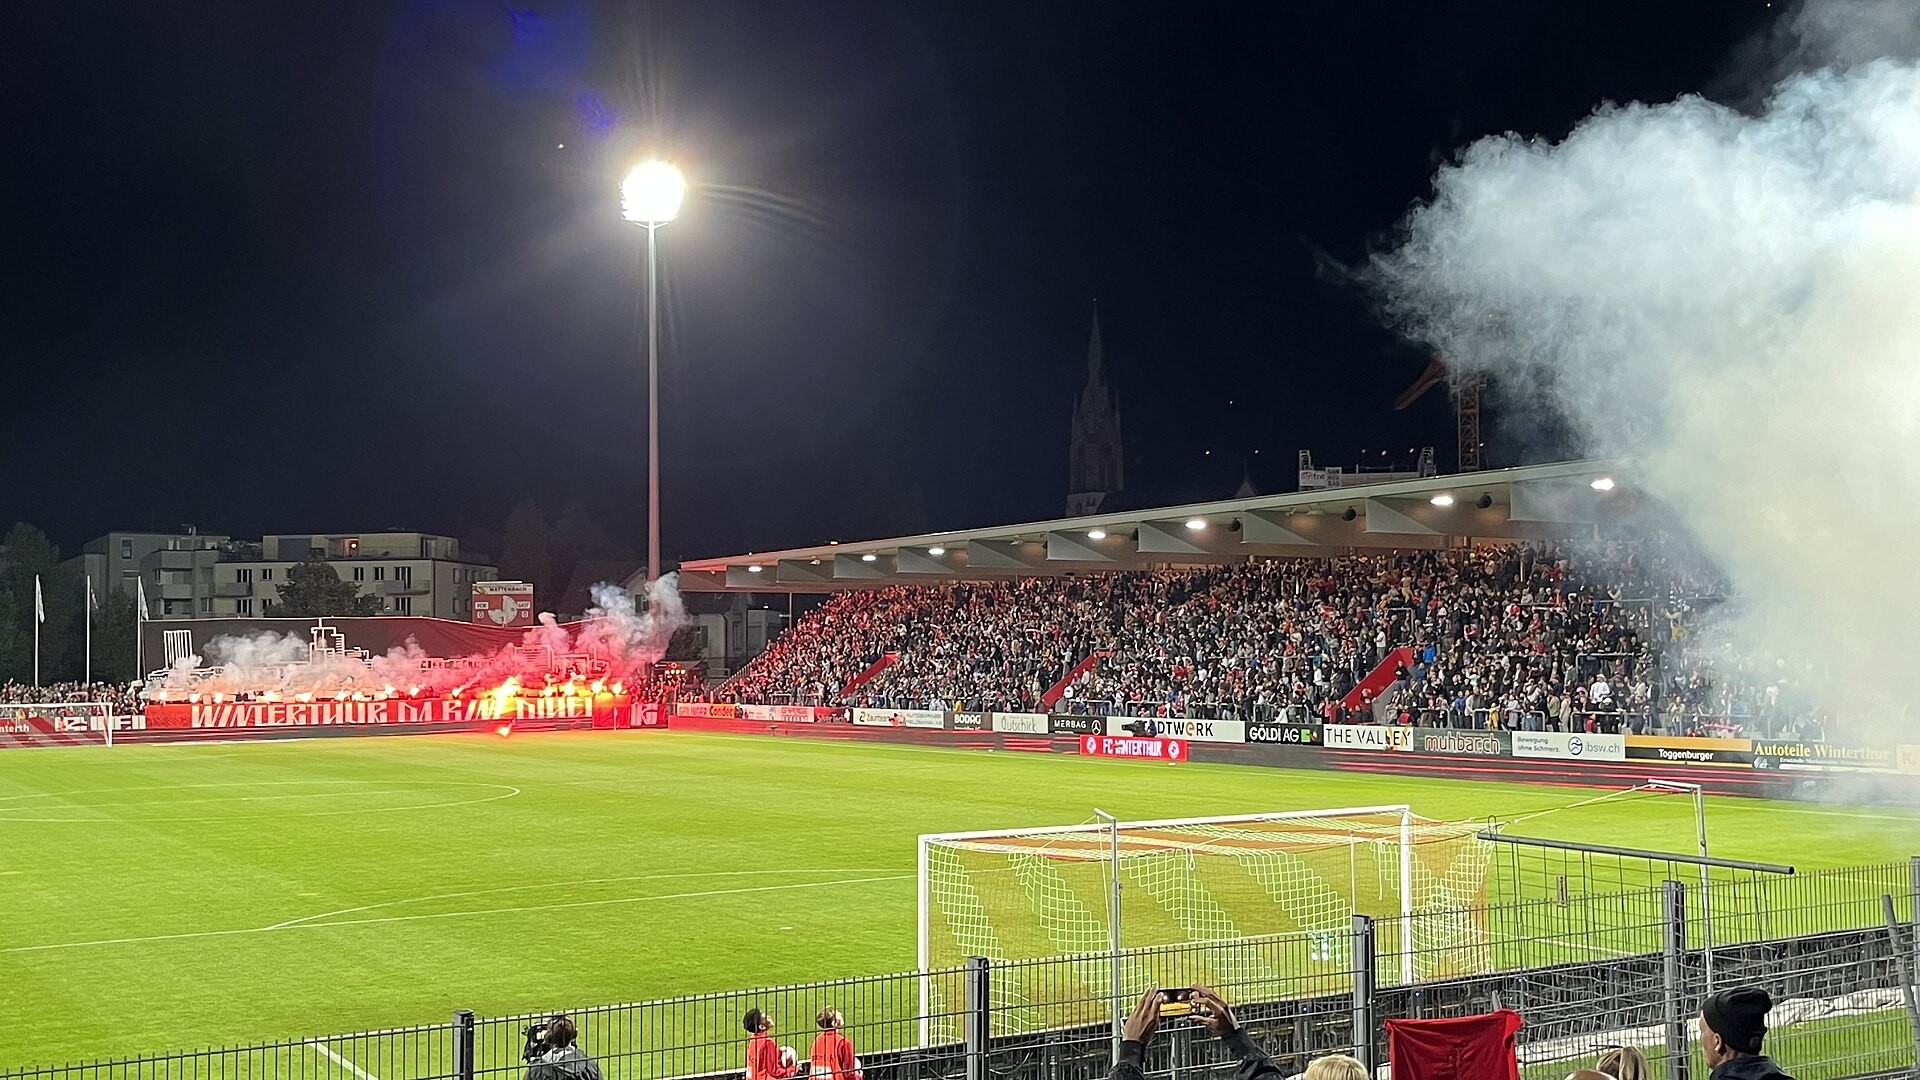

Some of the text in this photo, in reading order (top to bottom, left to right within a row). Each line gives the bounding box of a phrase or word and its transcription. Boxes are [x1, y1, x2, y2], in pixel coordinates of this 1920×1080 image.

[192, 702, 388, 728] WINTERTHUR
[954, 713, 982, 725] BODAG
[1054, 719, 1086, 729] MERBAG
[1283, 727, 1299, 743] AG
[1326, 728, 1352, 743] THE
[1517, 736, 1548, 745] Bewegung
[1103, 738, 1162, 757] FC WINTERTHUR
[1658, 748, 1714, 761] Toggenburger
[1754, 742, 1811, 757] Autoteile
[1814, 744, 1890, 760] Winterthur
